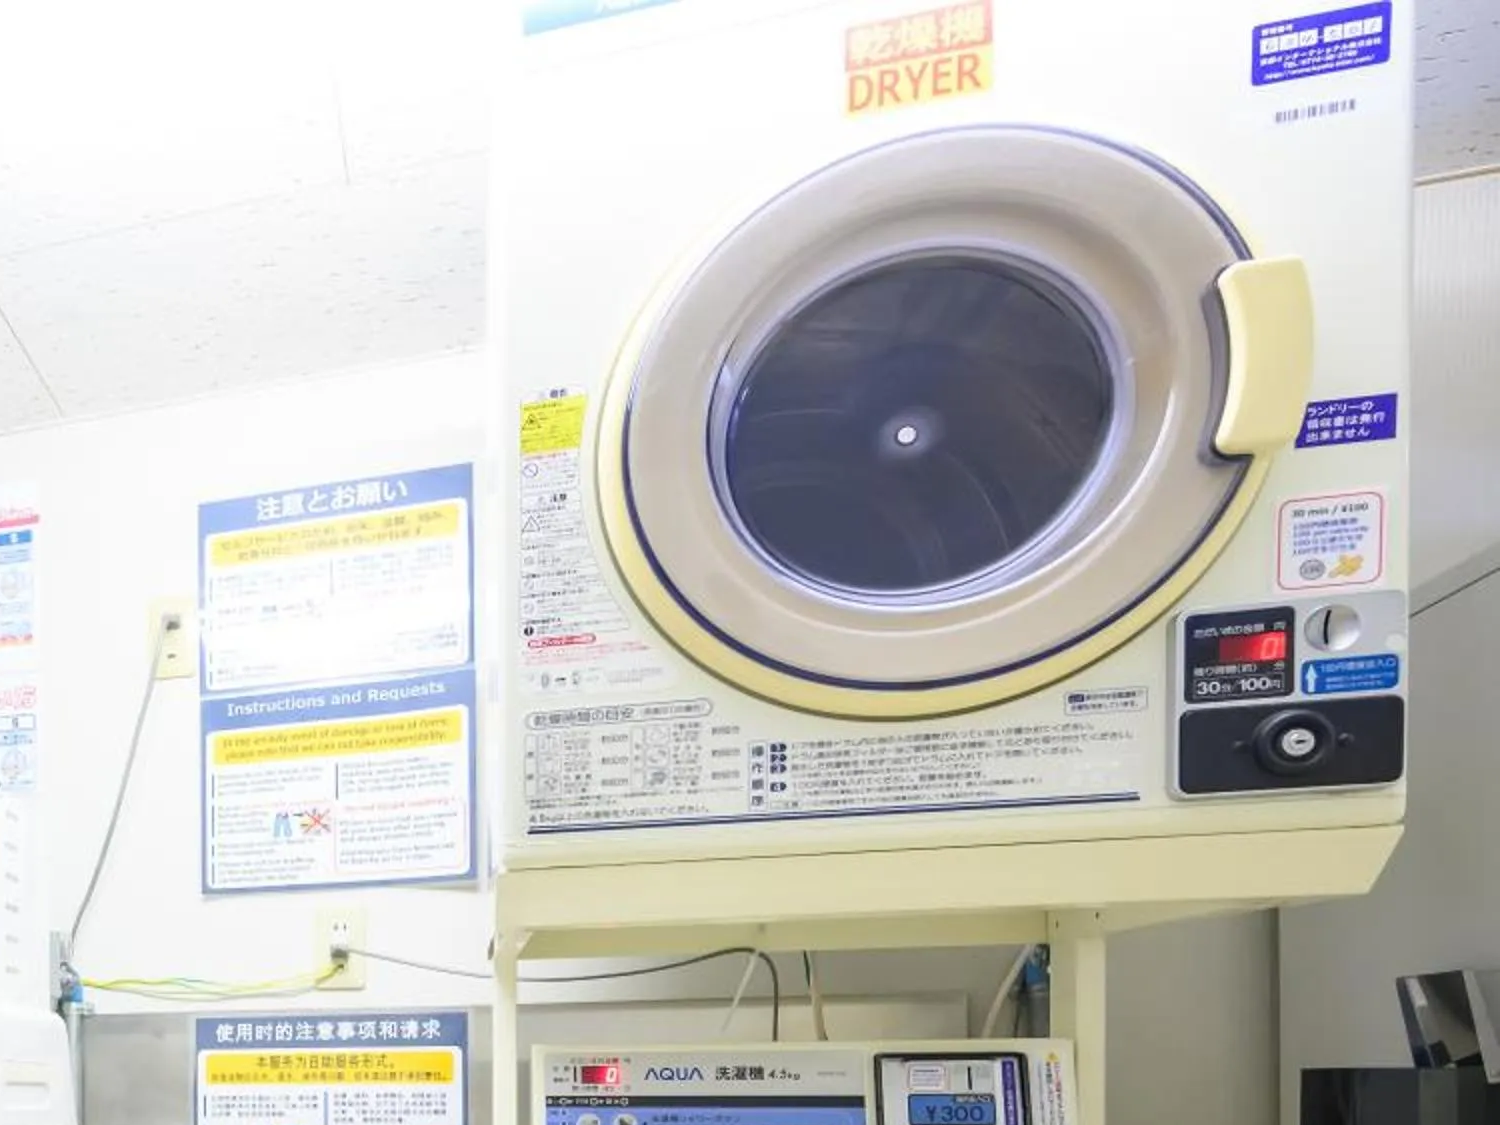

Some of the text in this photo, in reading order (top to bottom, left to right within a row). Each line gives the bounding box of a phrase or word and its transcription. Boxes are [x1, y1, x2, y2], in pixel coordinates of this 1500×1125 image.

[849, 53, 982, 112] DRYER
[256, 479, 408, 521] 注意とお願い
[227, 680, 445, 718] Instructions and Requests
[215, 1018, 442, 1043] 使用时的注意事项和请求
[644, 1066, 705, 1081] AQUA
[715, 1065, 766, 1081] 洗濯機
